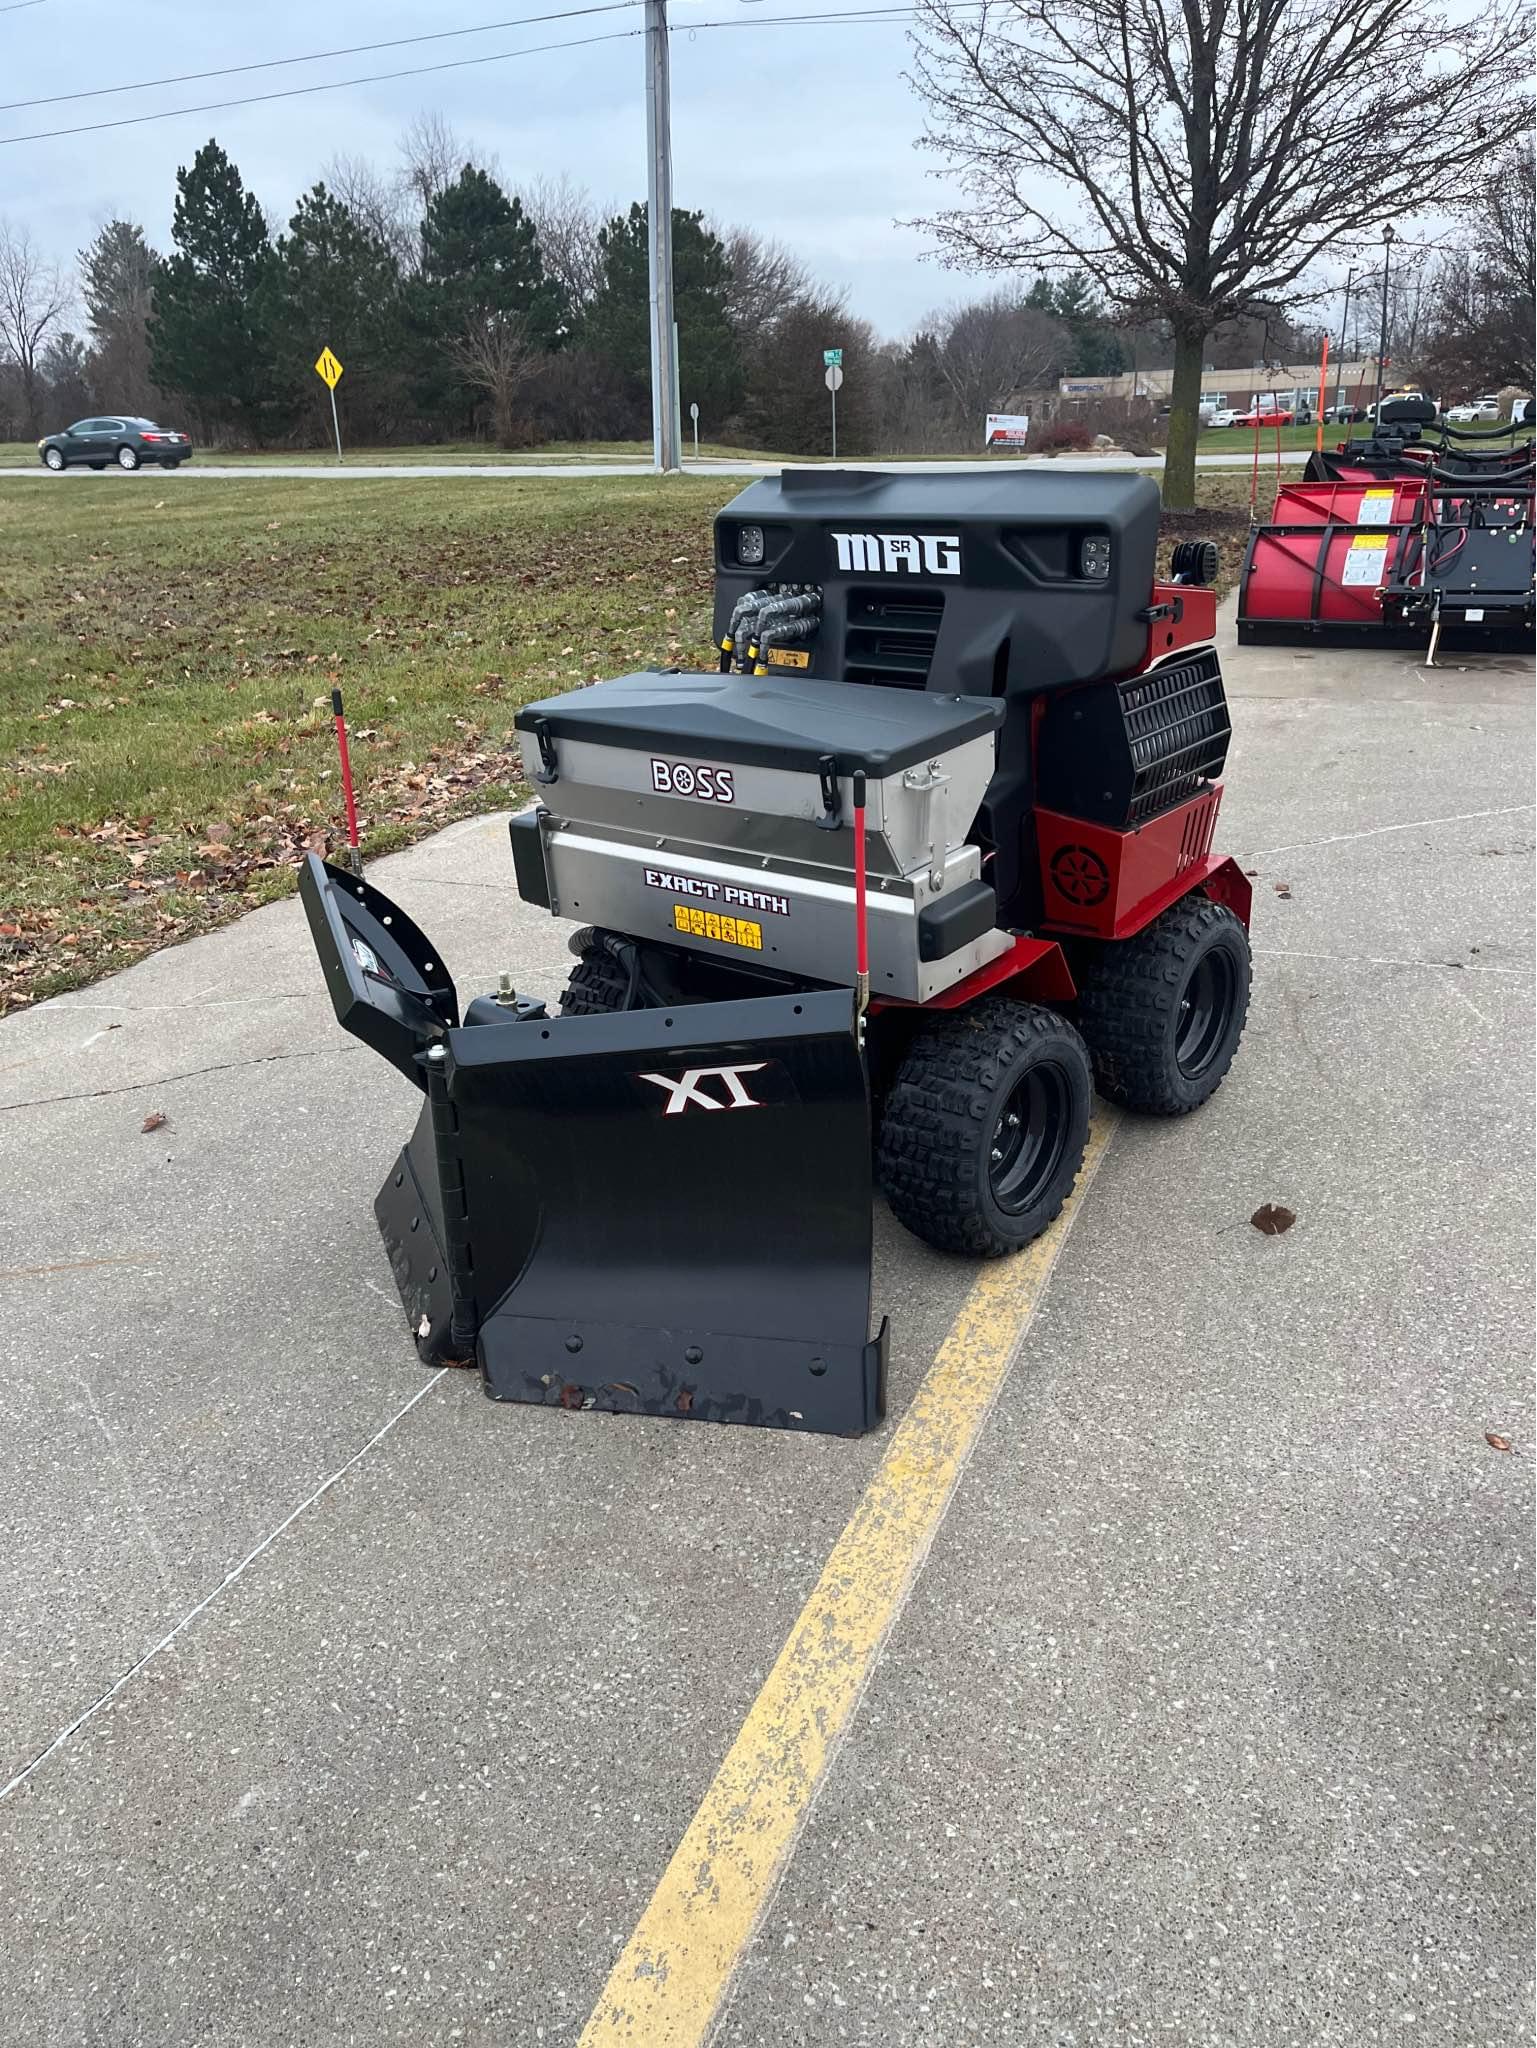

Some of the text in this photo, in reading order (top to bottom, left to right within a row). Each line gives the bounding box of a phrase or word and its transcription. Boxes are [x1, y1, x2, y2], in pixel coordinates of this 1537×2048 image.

[830, 533, 961, 575] MAG
[890, 540, 912, 553] SR
[651, 759, 735, 803] BOSS
[644, 868, 790, 916] EXACT PATH
[638, 1062, 769, 1115] XT
